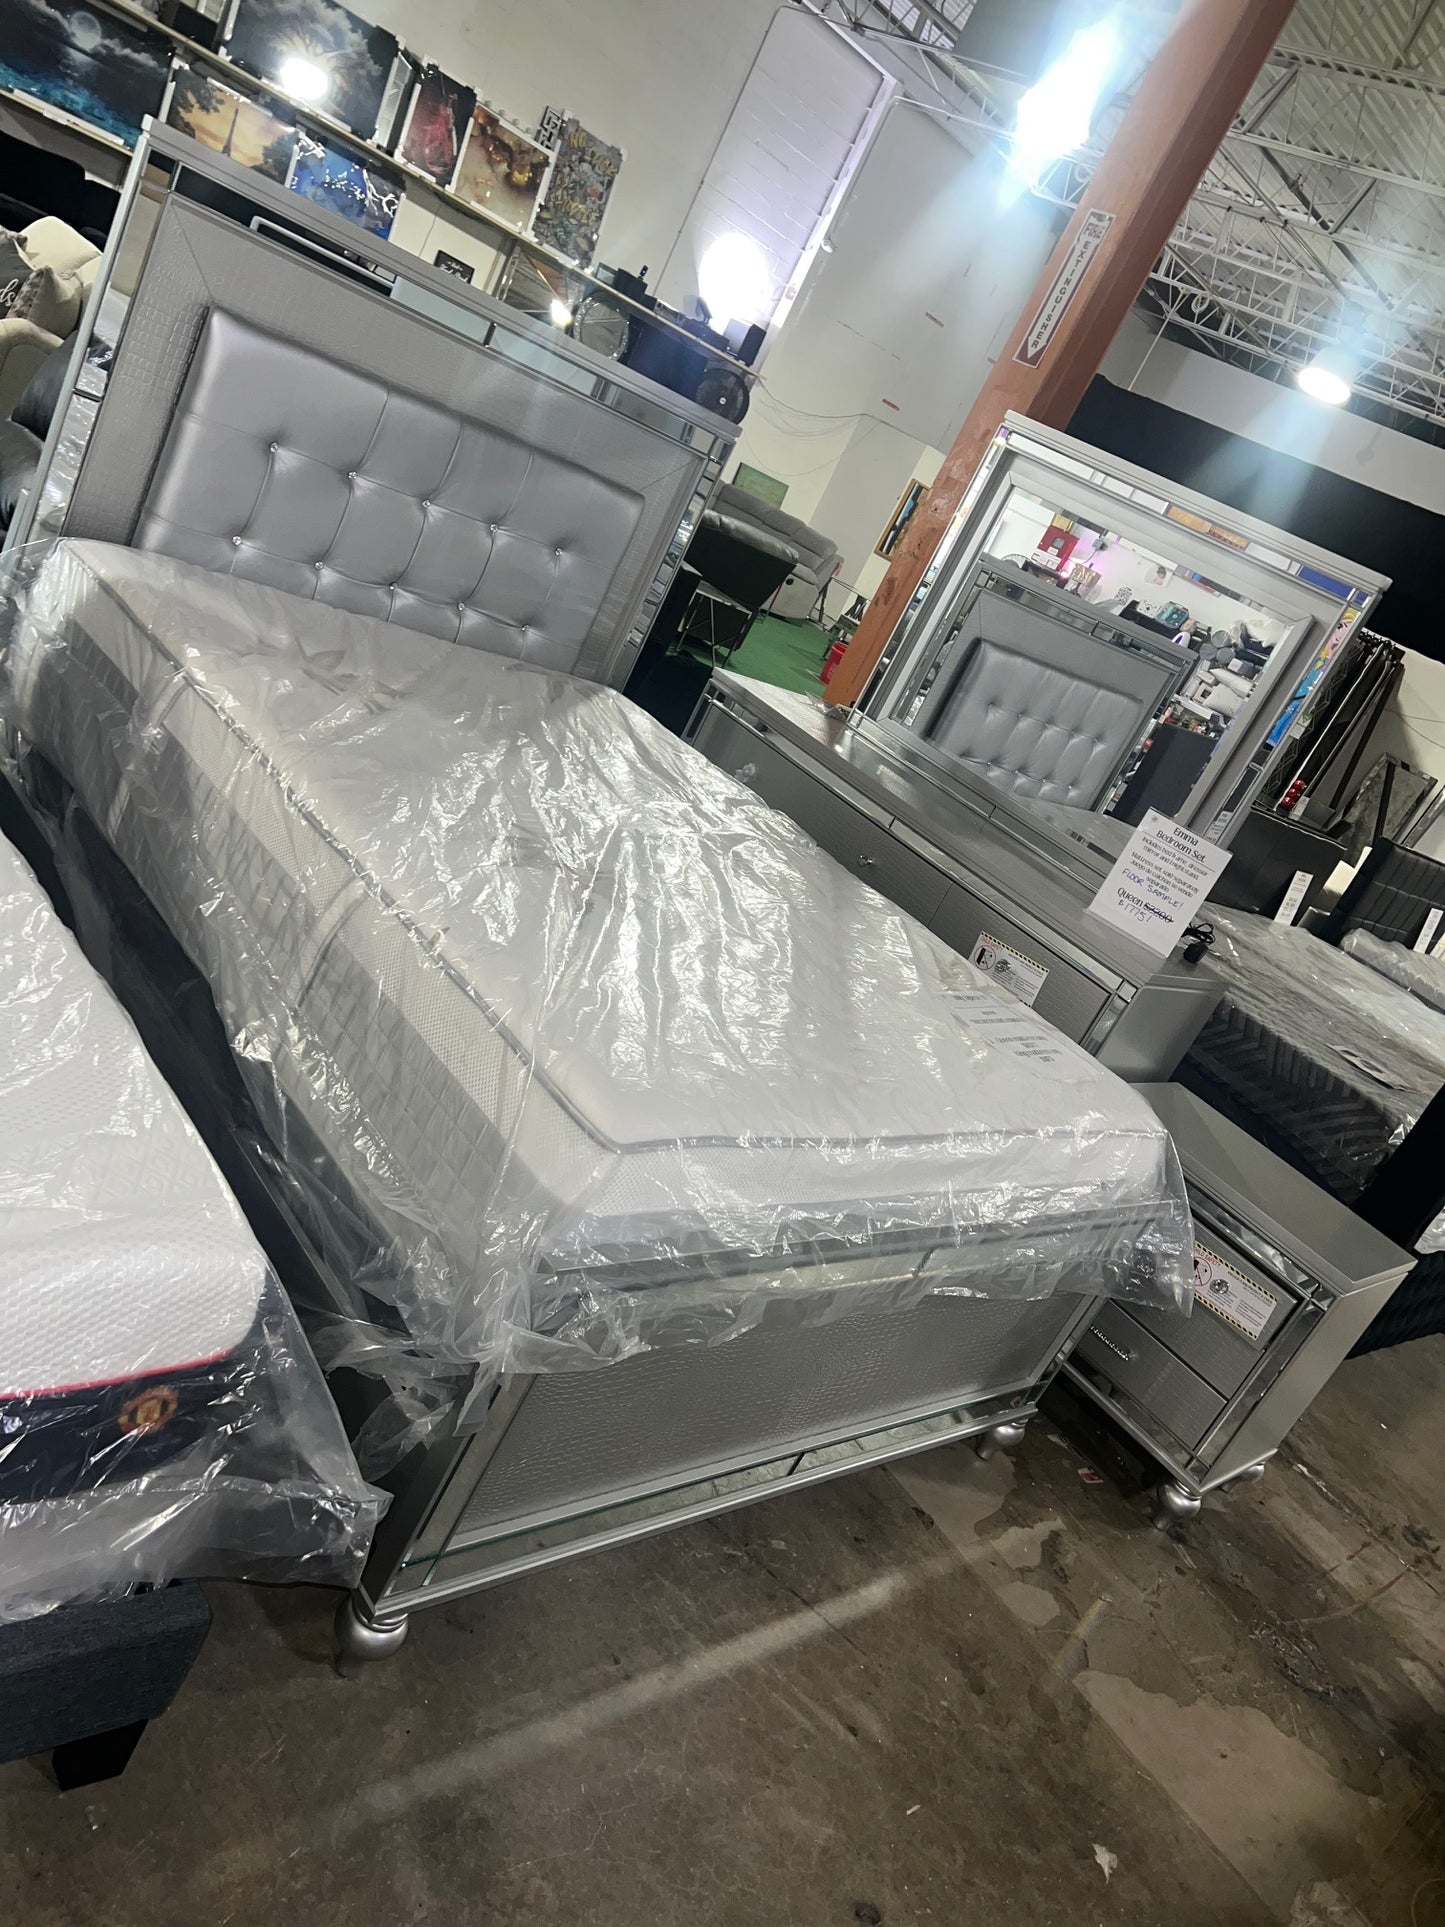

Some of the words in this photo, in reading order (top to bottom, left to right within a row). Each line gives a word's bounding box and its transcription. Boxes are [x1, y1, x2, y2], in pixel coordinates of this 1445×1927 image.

[1031, 240, 1092, 350] EXTINGUISHER
[1155, 829, 1192, 855] Bedroom
[1191, 849, 1206, 863] Set
[1173, 826, 1199, 846] Emma
[1117, 887, 1144, 907] Queen
[1121, 867, 1144, 887] FLOOR
[1146, 884, 1184, 909] SAMPLE!
